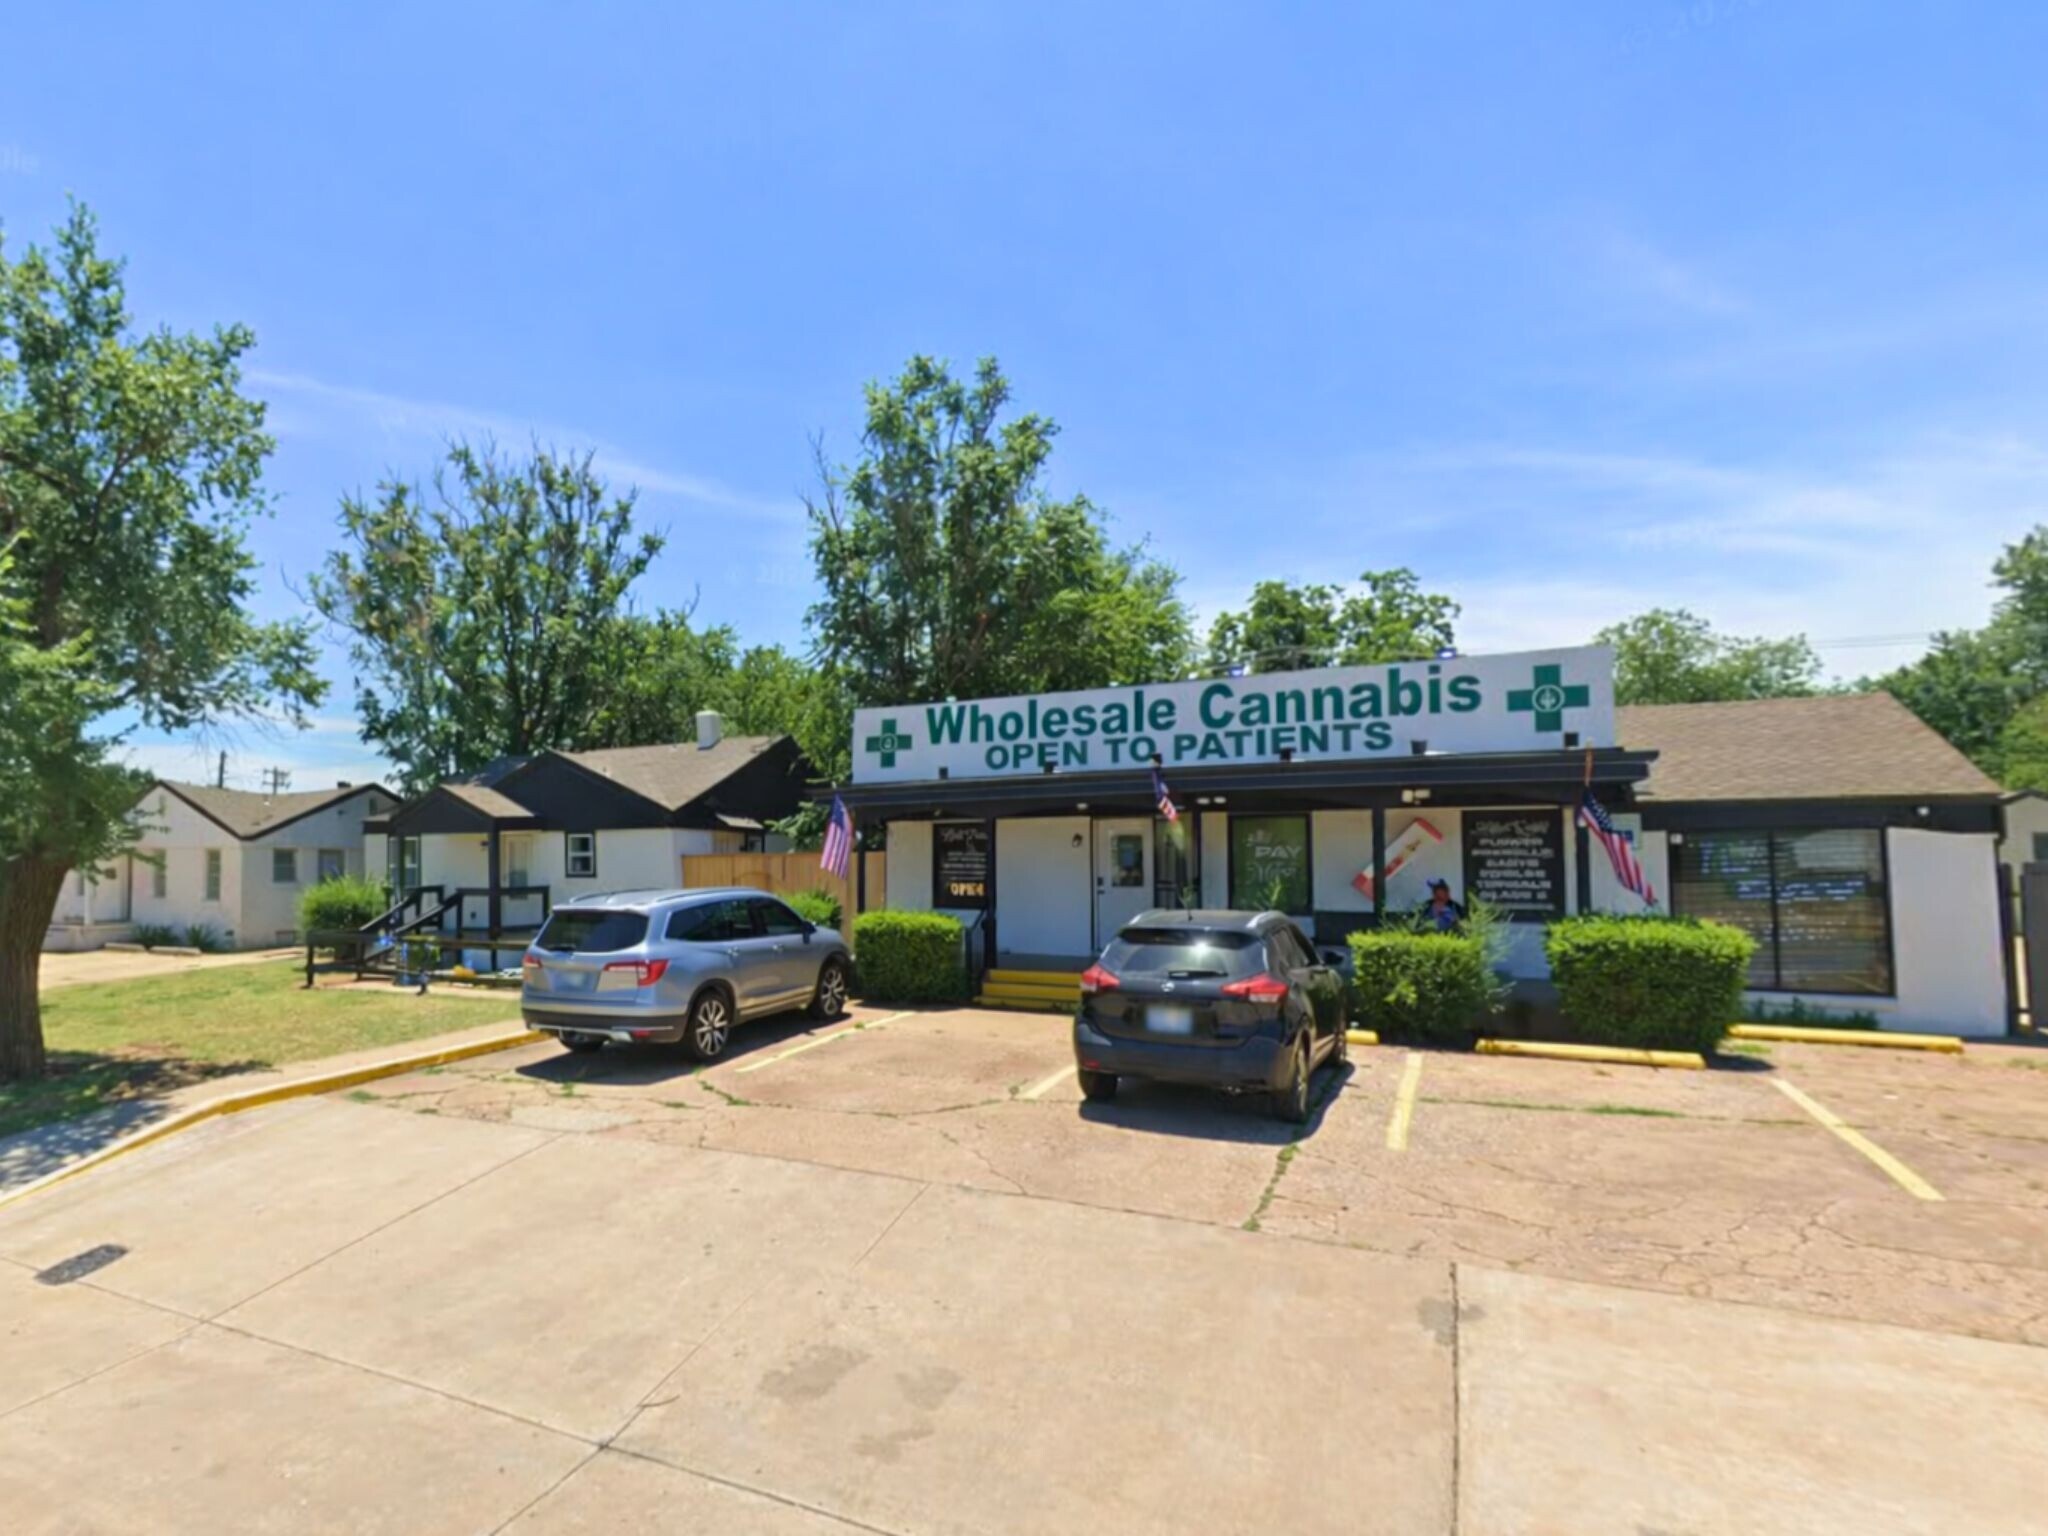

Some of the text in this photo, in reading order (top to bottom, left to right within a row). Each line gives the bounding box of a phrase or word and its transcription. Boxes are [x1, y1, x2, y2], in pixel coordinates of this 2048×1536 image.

[926, 665, 1482, 745] Wholesale Cannabis
[985, 721, 1392, 770] OPEN TO PATIENTS
